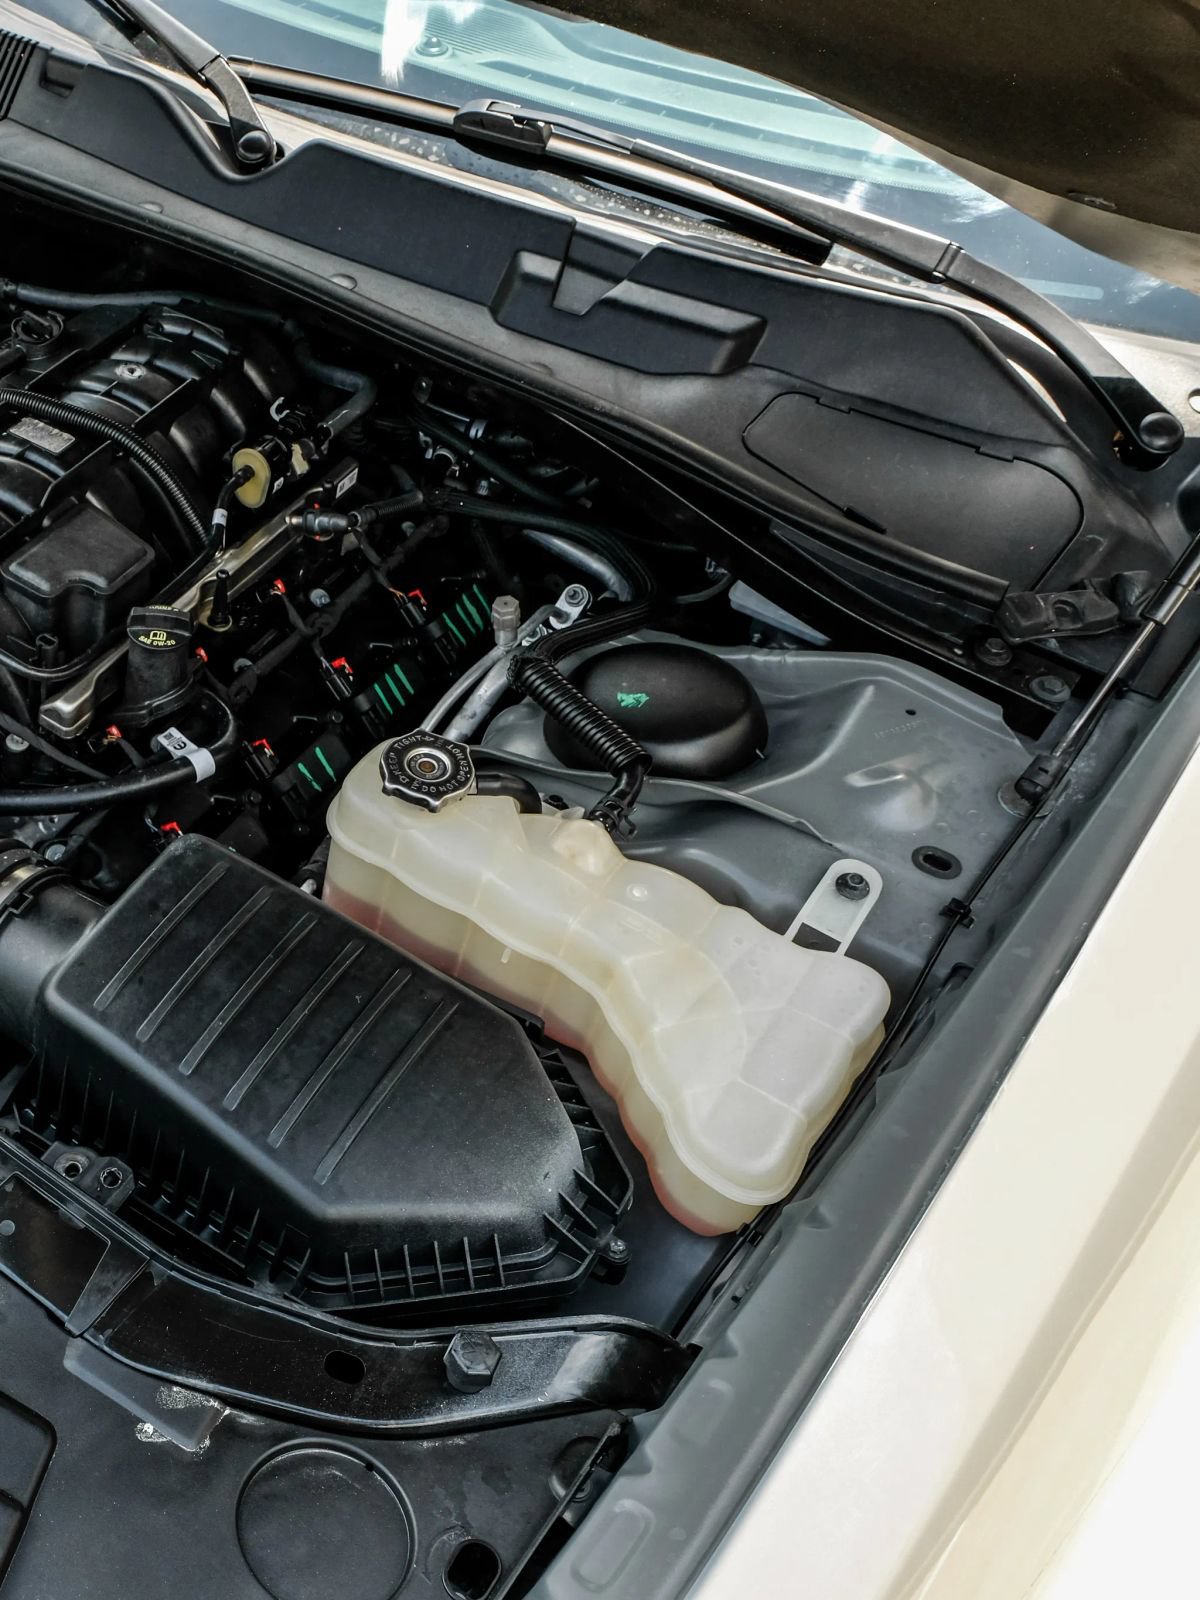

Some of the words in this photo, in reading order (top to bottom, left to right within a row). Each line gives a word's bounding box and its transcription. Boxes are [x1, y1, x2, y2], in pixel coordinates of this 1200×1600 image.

[138, 635, 152, 645] SAE
[393, 735, 422, 750] TIGHT
[446, 744, 465, 760] HOT
[388, 752, 402, 776] KEEP
[456, 760, 469, 782] OPEN
[422, 785, 437, 793] DO
[438, 779, 459, 792] NOT
